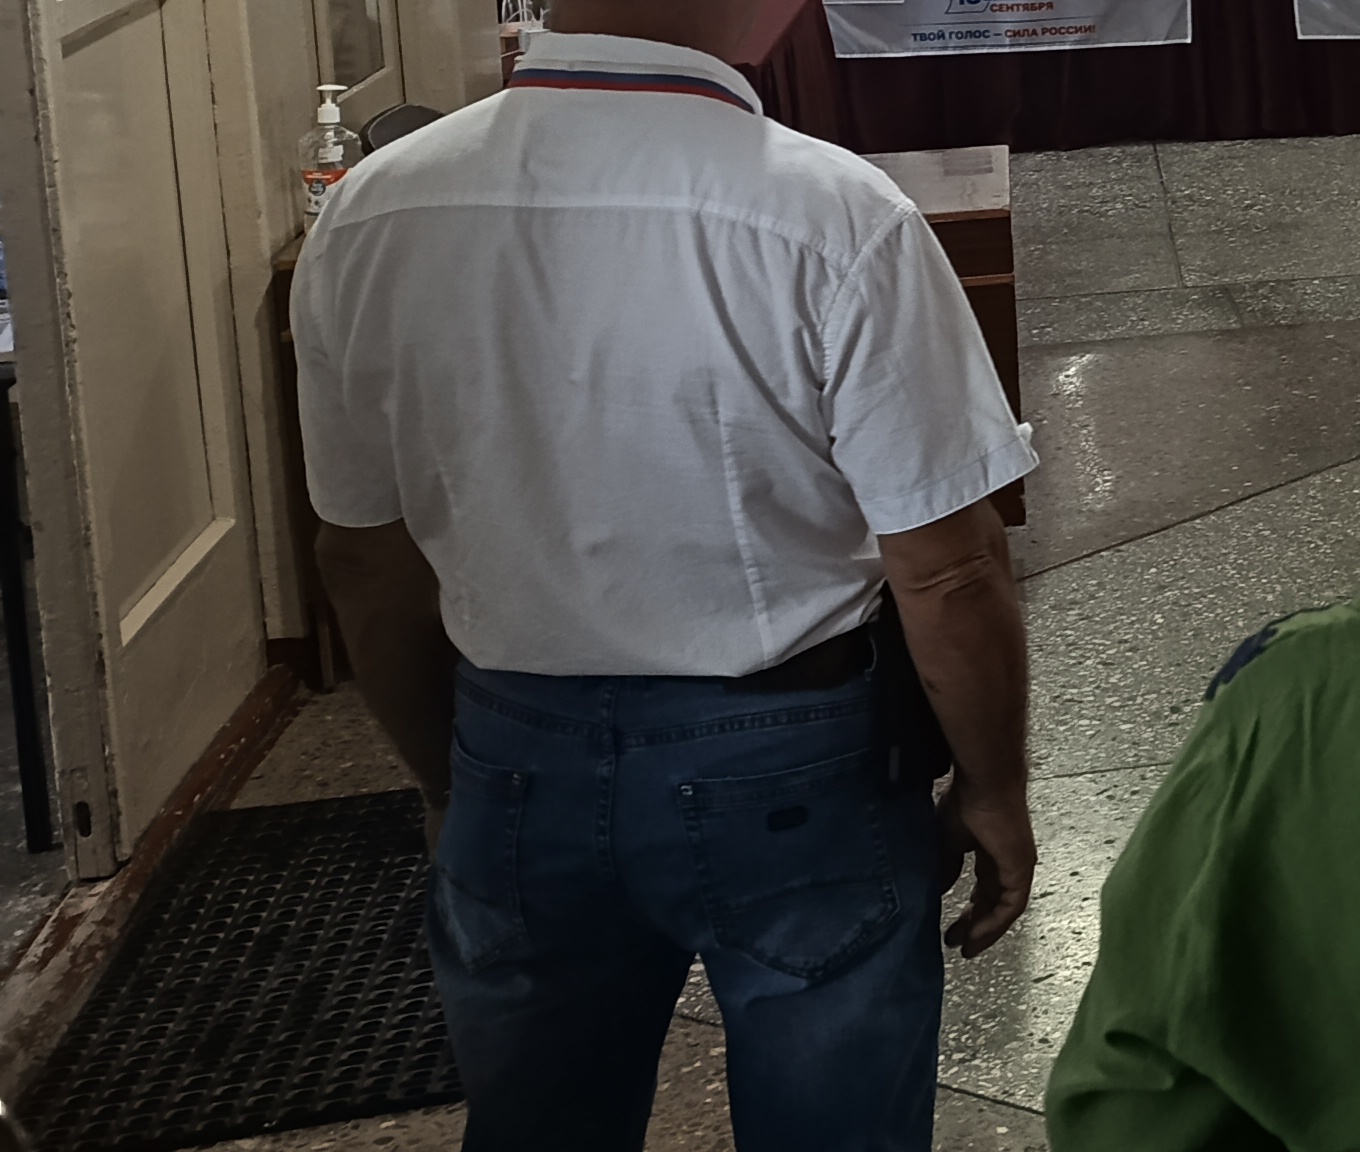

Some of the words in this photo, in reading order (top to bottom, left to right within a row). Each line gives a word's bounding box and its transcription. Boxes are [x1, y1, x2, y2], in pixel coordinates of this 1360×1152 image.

[990, 2, 1053, 13] СЕНТЯБРЯ
[911, 30, 945, 42] ТВОЙ
[949, 29, 990, 39] ГОЛОС
[1004, 28, 1038, 38] СИЛА
[1041, 25, 1096, 36] РОССИИ!
